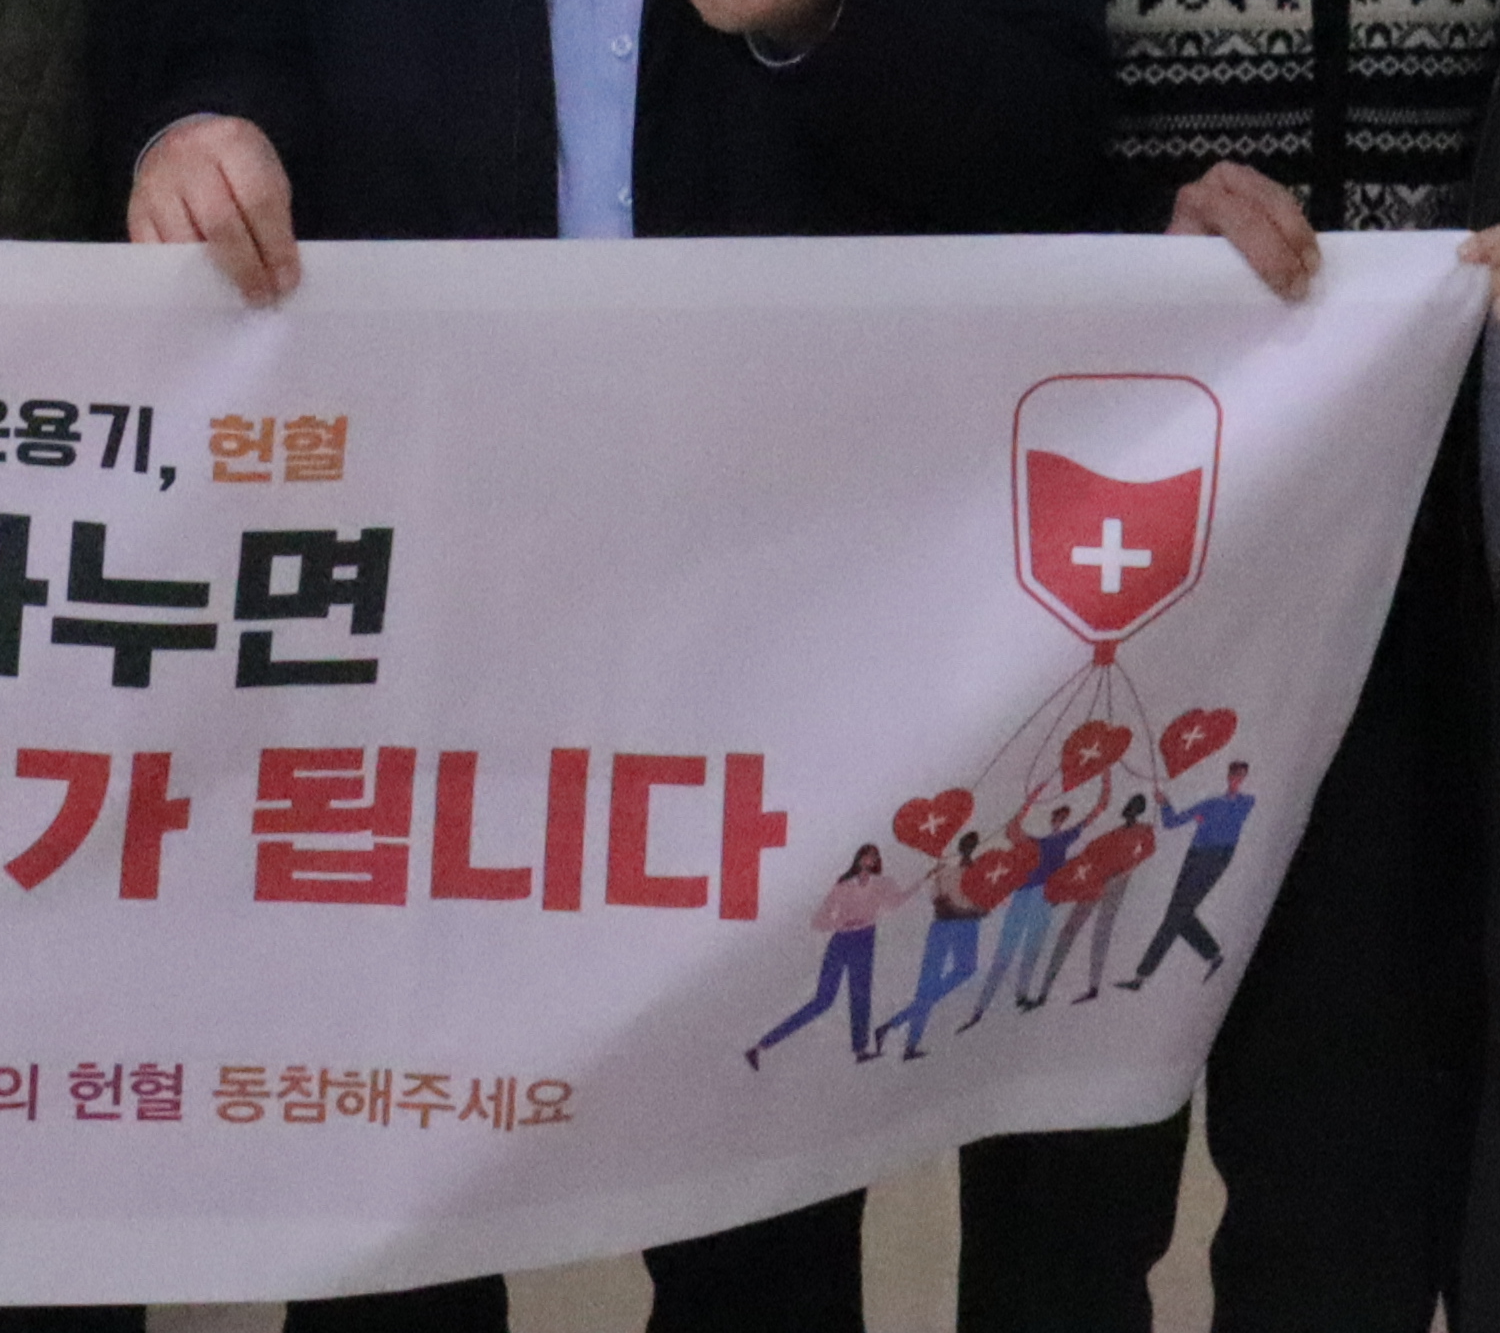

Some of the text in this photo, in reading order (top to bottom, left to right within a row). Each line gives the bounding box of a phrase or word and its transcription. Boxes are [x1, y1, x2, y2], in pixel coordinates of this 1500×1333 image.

[208, 414, 350, 484] 헌혈
[250, 744, 788, 922] 됩니다
[68, 1062, 184, 1122] 헌혈
[211, 1065, 583, 1133] 동참해주세요
